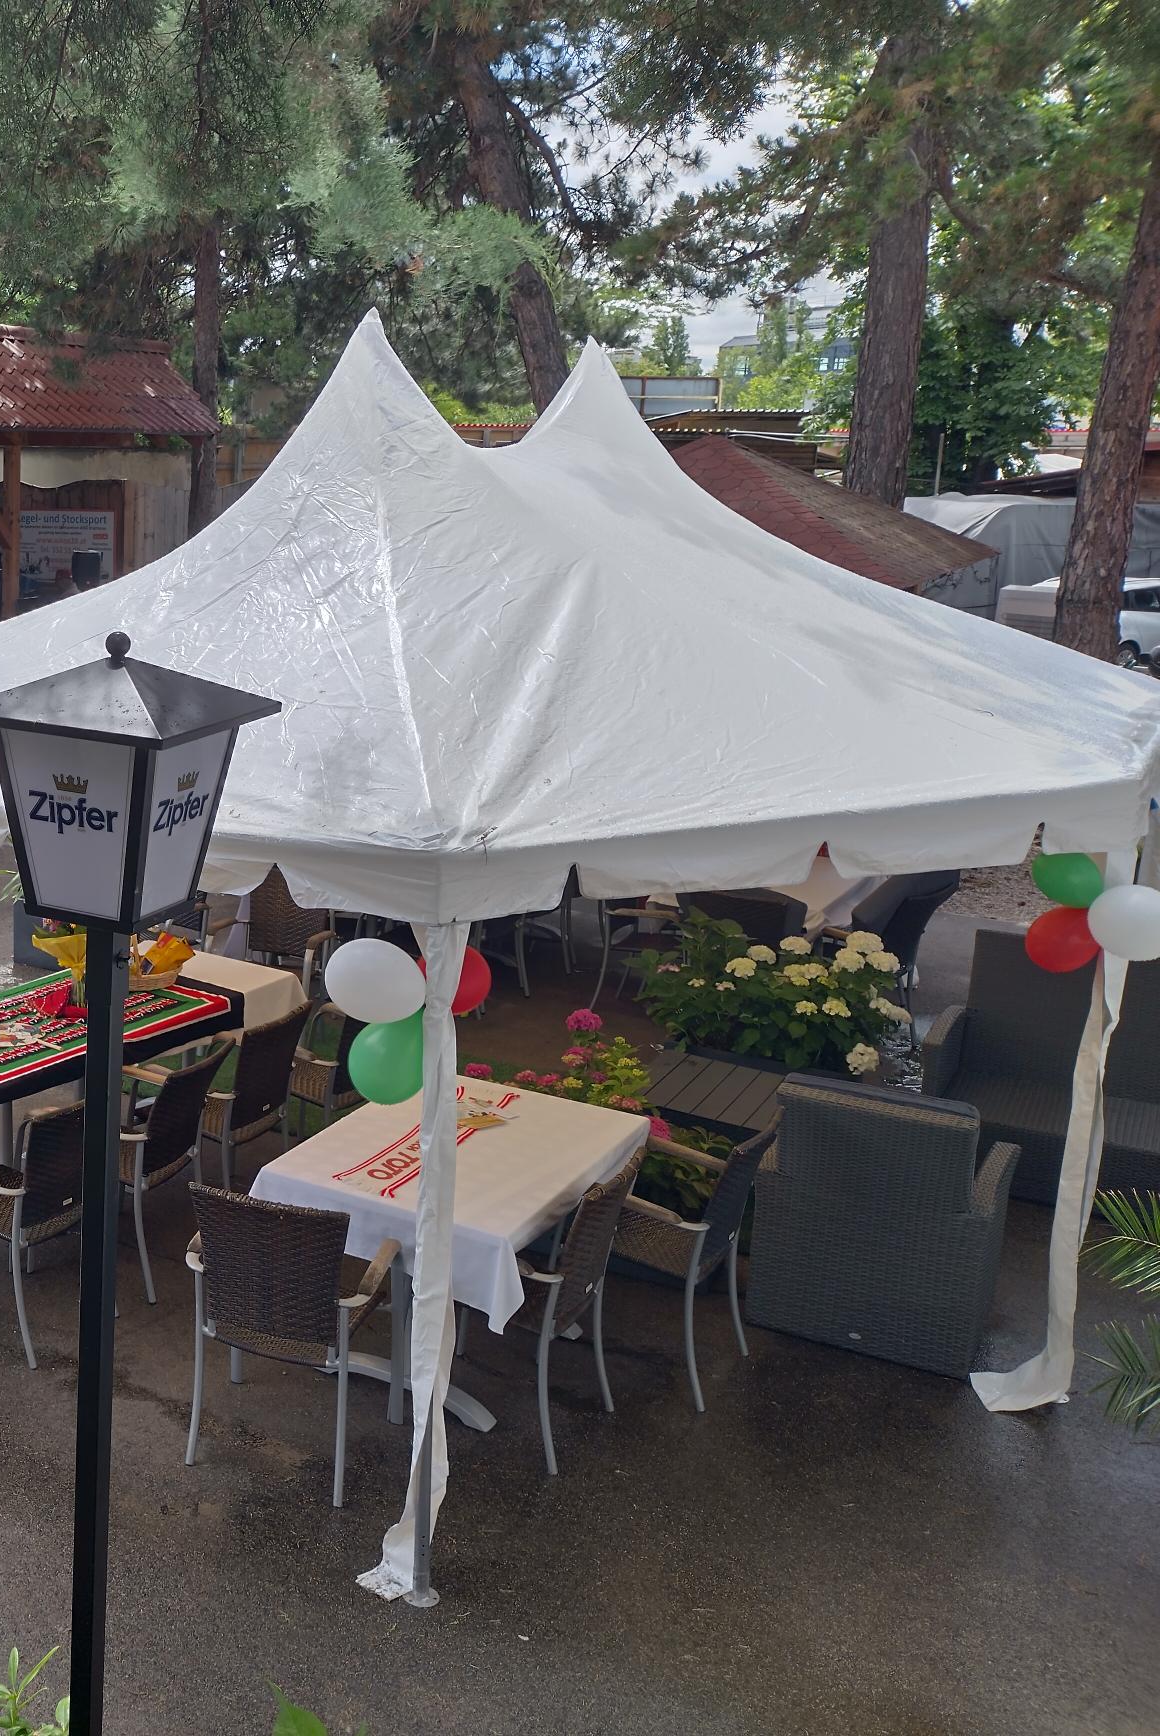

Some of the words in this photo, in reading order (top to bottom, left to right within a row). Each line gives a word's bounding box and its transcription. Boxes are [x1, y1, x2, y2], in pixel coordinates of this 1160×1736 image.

[19, 514, 41, 525] egel-
[43, 514, 60, 524] und
[62, 514, 107, 526] Stocksport
[28, 789, 119, 834] Zipfer
[152, 790, 210, 836] Zipfer
[367, 1151, 420, 1180] TOTO
